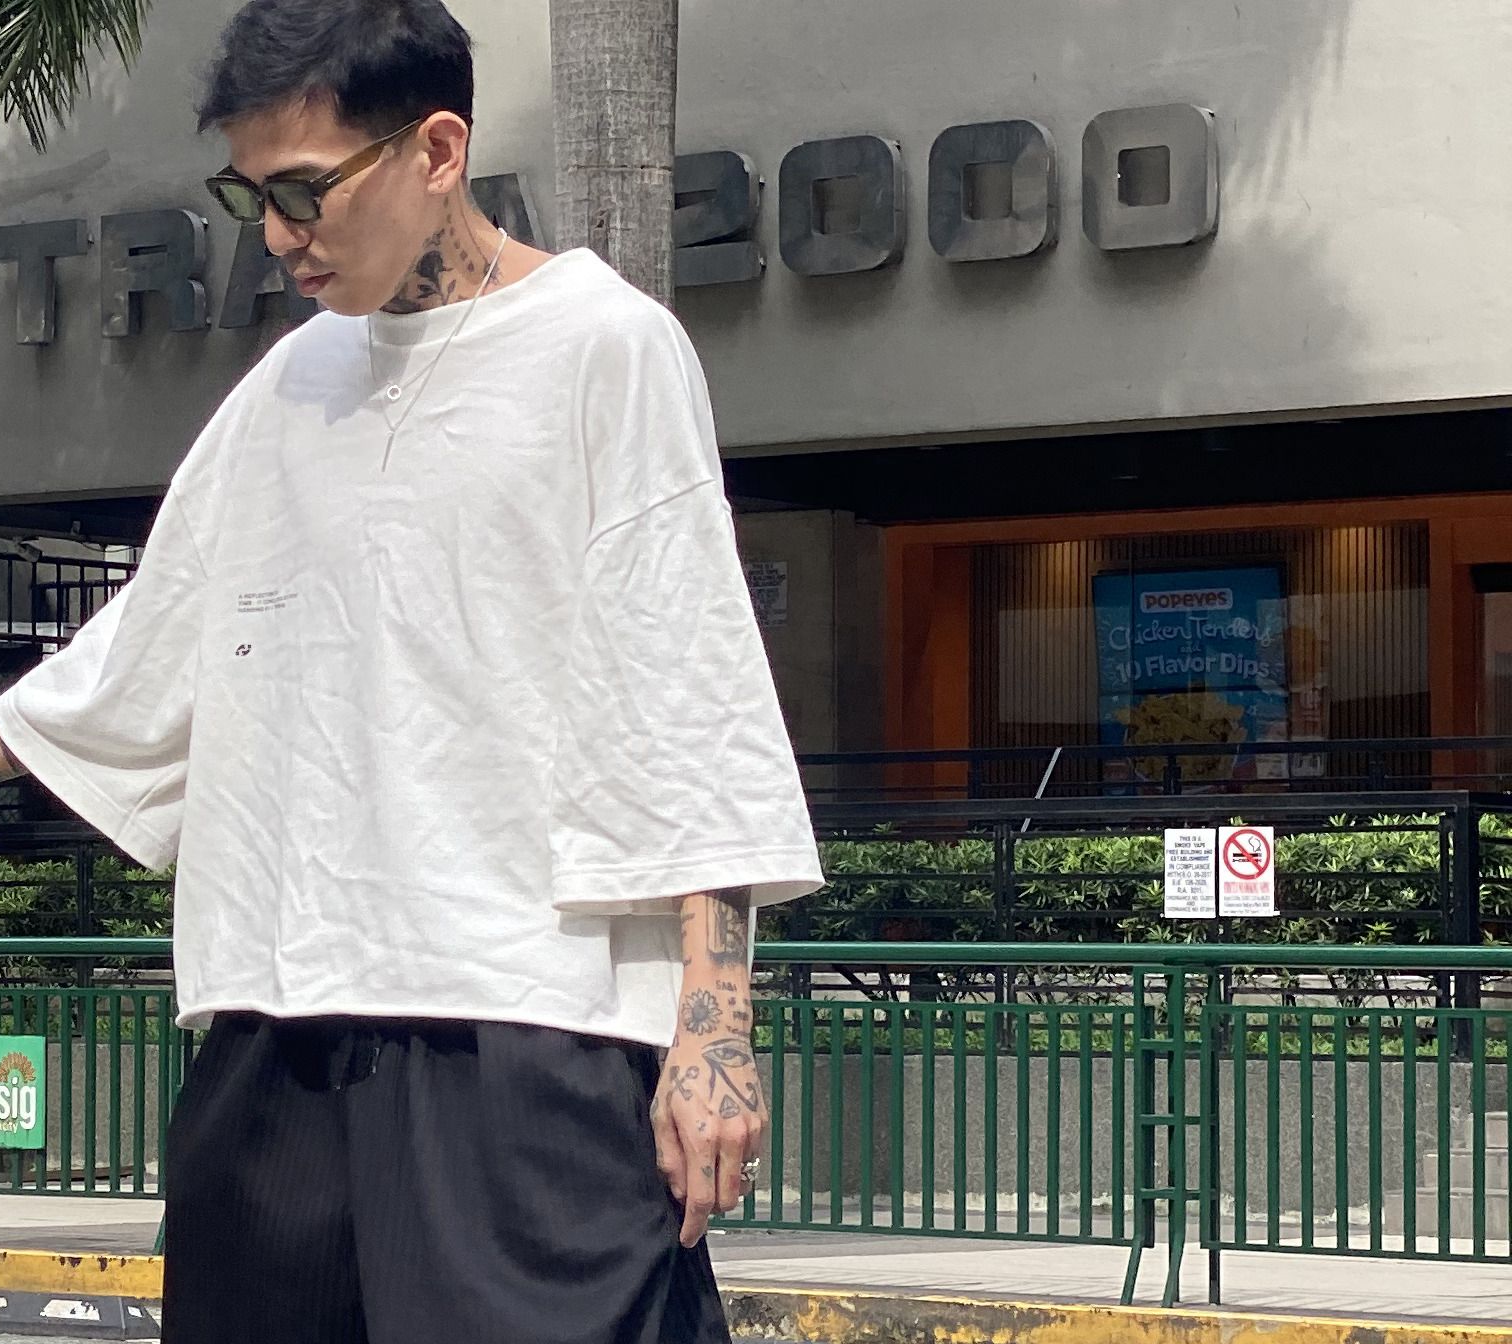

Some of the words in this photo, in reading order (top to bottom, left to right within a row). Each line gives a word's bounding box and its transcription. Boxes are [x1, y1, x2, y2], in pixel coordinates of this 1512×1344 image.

[1109, 620, 1192, 650] Chicken
[1189, 616, 1272, 647] Tenders
[1146, 654, 1217, 677] Flavor
[1219, 653, 1270, 680] Dips
